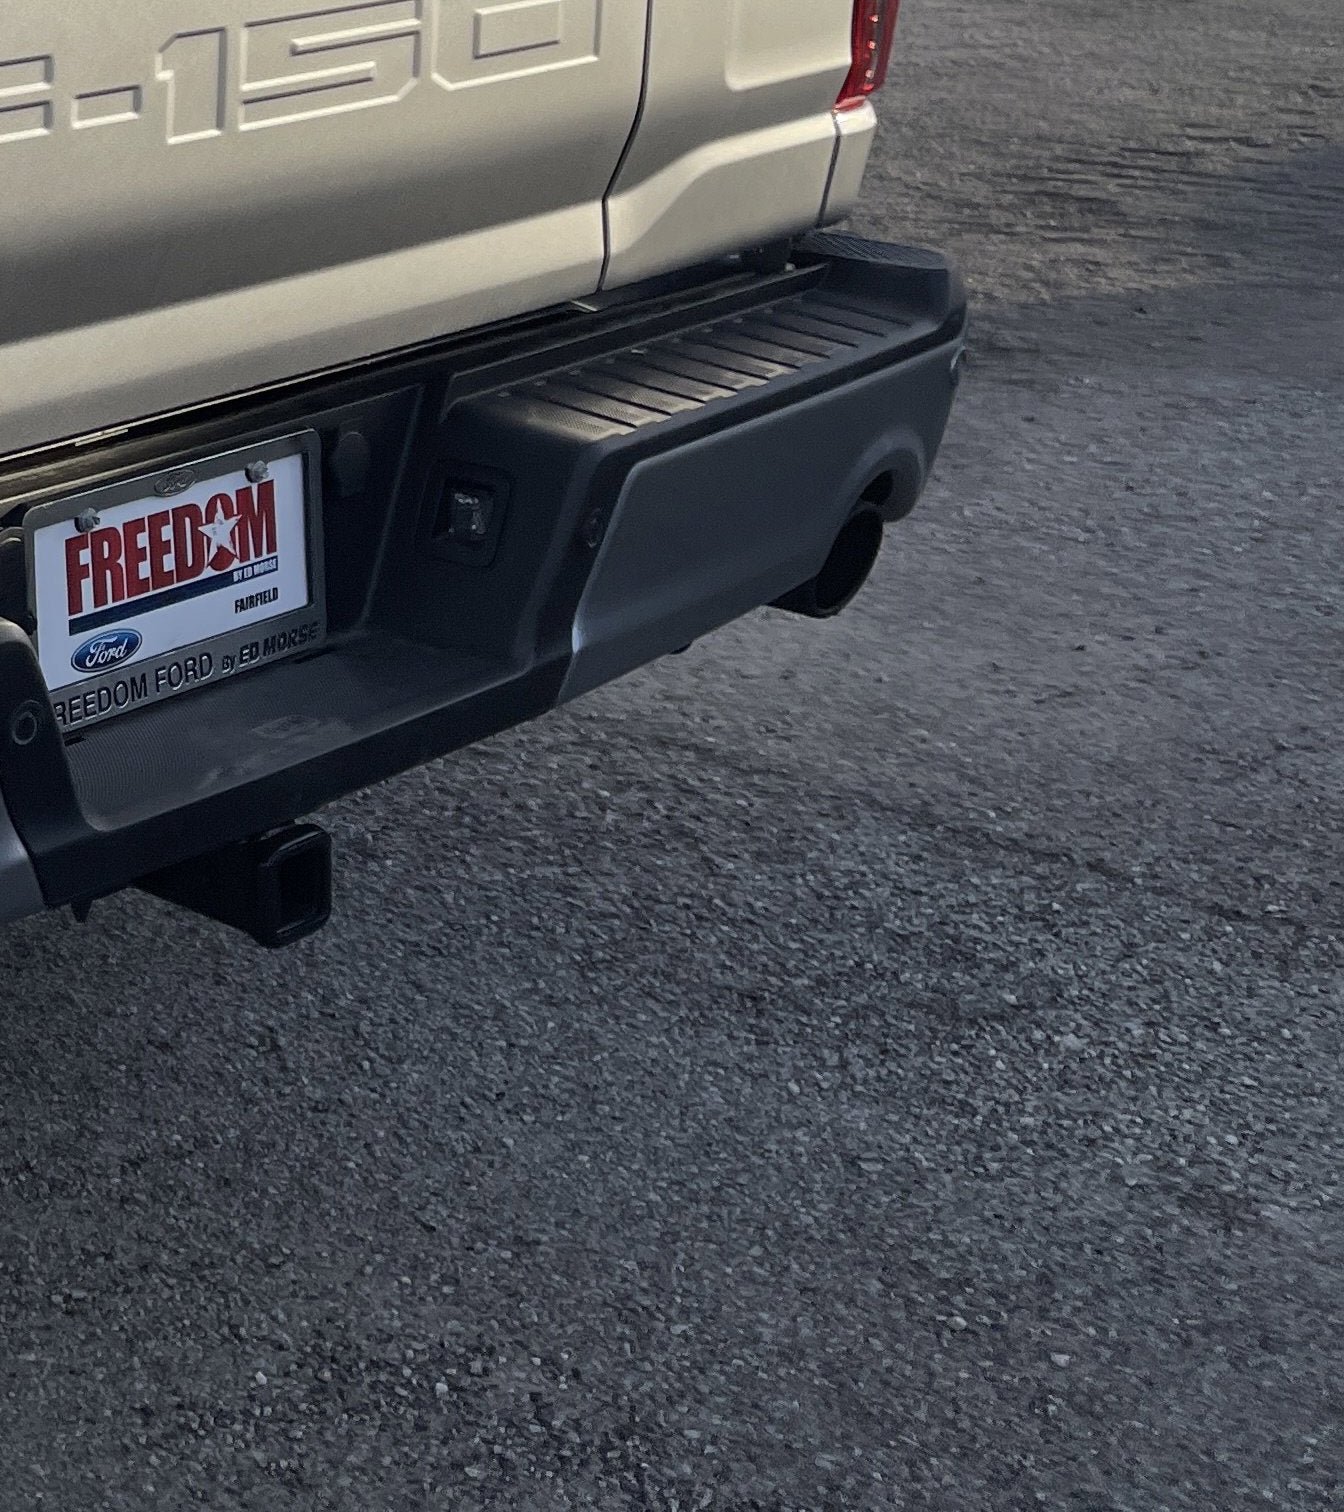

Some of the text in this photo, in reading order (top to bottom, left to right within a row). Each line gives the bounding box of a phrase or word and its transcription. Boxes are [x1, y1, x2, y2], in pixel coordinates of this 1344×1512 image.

[63, 478, 279, 617] FREEDOM
[234, 587, 279, 614] FAIRFIELD
[53, 672, 149, 726] REEDOM
[155, 651, 215, 694] FORD
[239, 640, 261, 668] ED
[262, 622, 320, 657] MORSE
[84, 634, 129, 668] Ford
